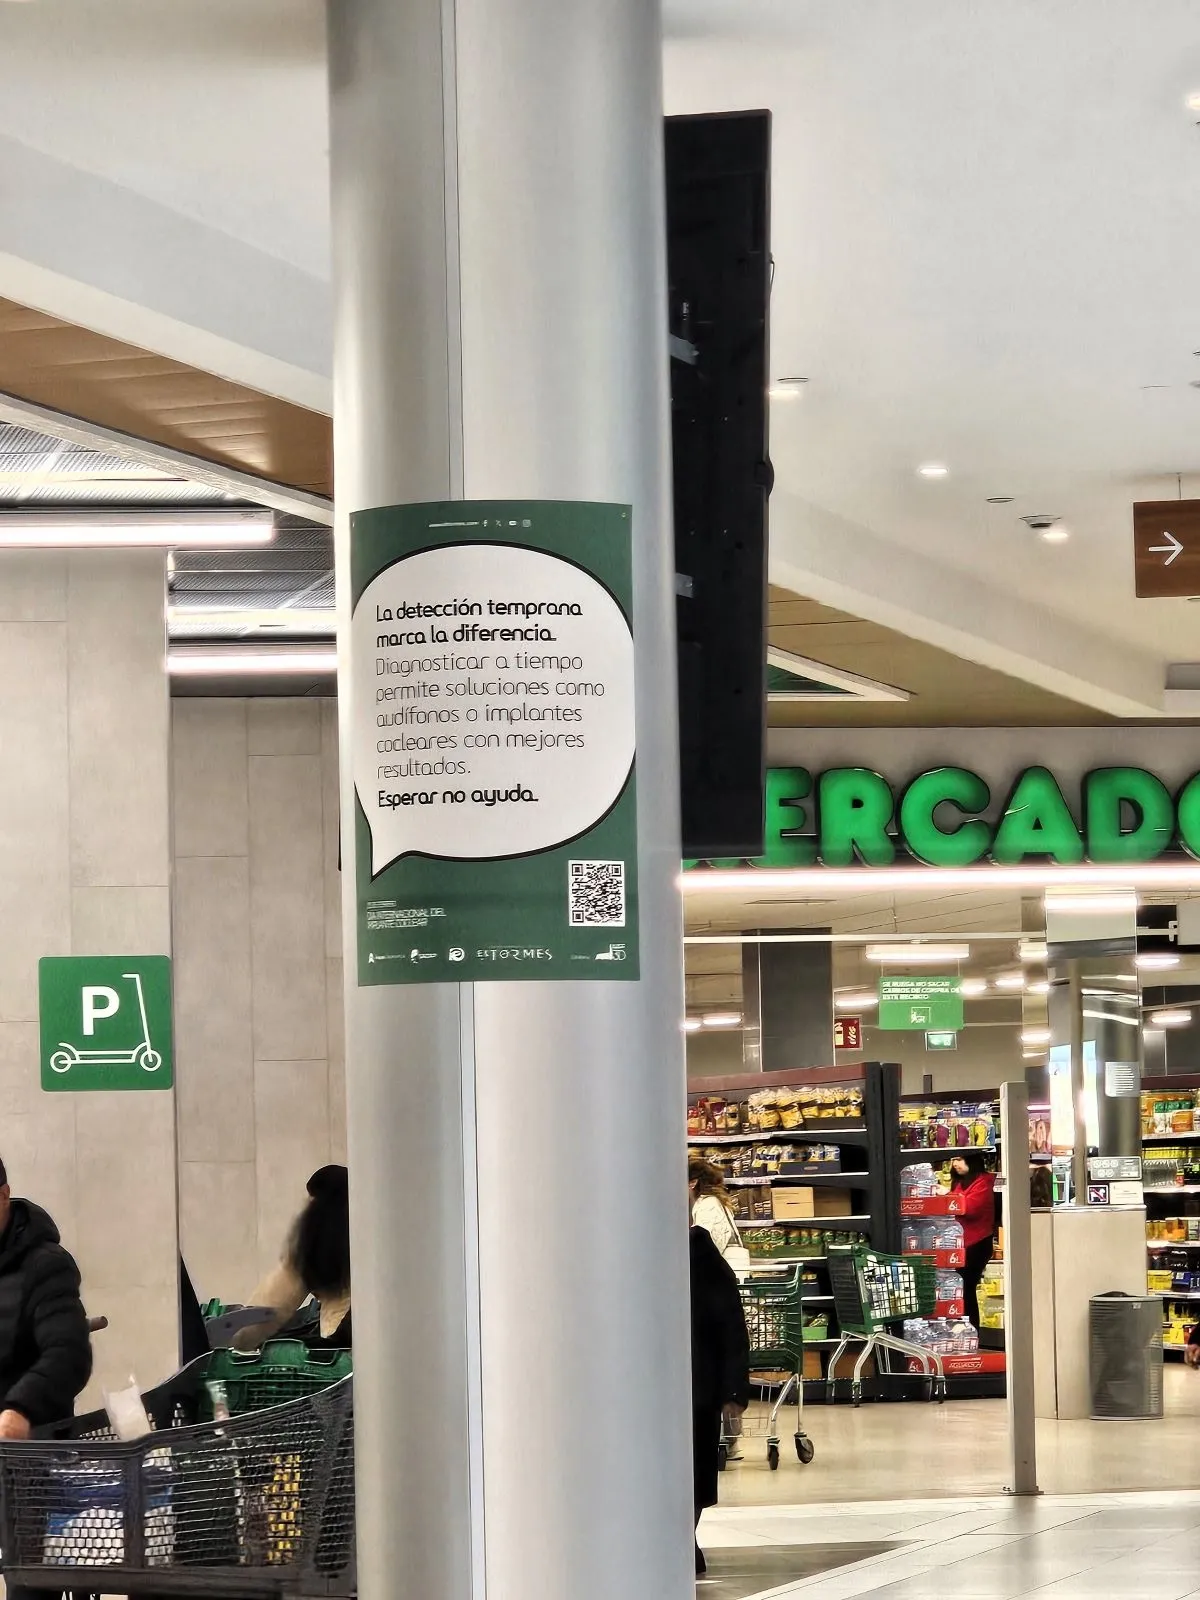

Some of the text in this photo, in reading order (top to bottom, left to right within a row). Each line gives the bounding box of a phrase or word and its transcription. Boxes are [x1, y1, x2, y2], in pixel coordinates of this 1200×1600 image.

[376, 598, 583, 622] La detección temprana
[376, 623, 557, 648] marca la diferencia.
[376, 652, 583, 677] Diagnosticar a tiempo
[376, 677, 605, 705] permite soluciones como
[376, 703, 583, 727] audífonos o implantes
[376, 729, 585, 753] cocleares con mejores
[377, 756, 472, 779] resultados.
[378, 783, 539, 810] Esperar no ayuda.
[681, 766, 1200, 869] ERCAD
[82, 985, 120, 1036] P
